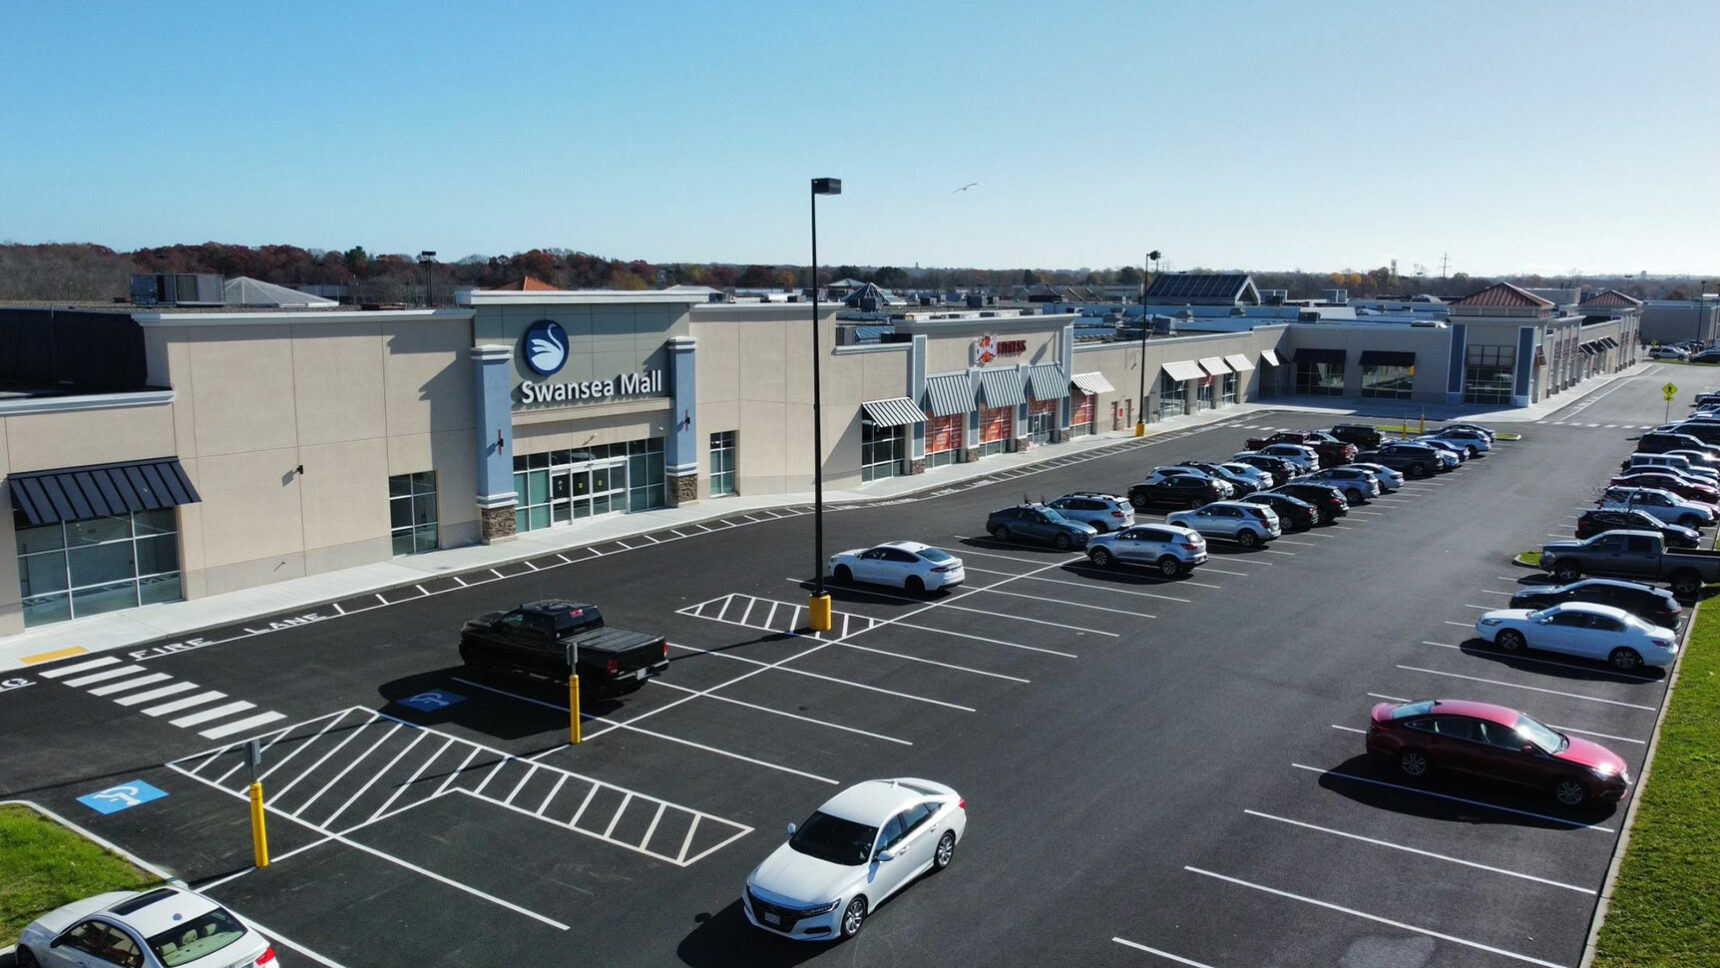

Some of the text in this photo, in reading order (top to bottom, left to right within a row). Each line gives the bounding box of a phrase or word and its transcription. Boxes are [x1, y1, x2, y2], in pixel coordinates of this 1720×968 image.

[521, 369, 662, 404] Swansea Mall
[128, 612, 327, 659] FIRE LANE
